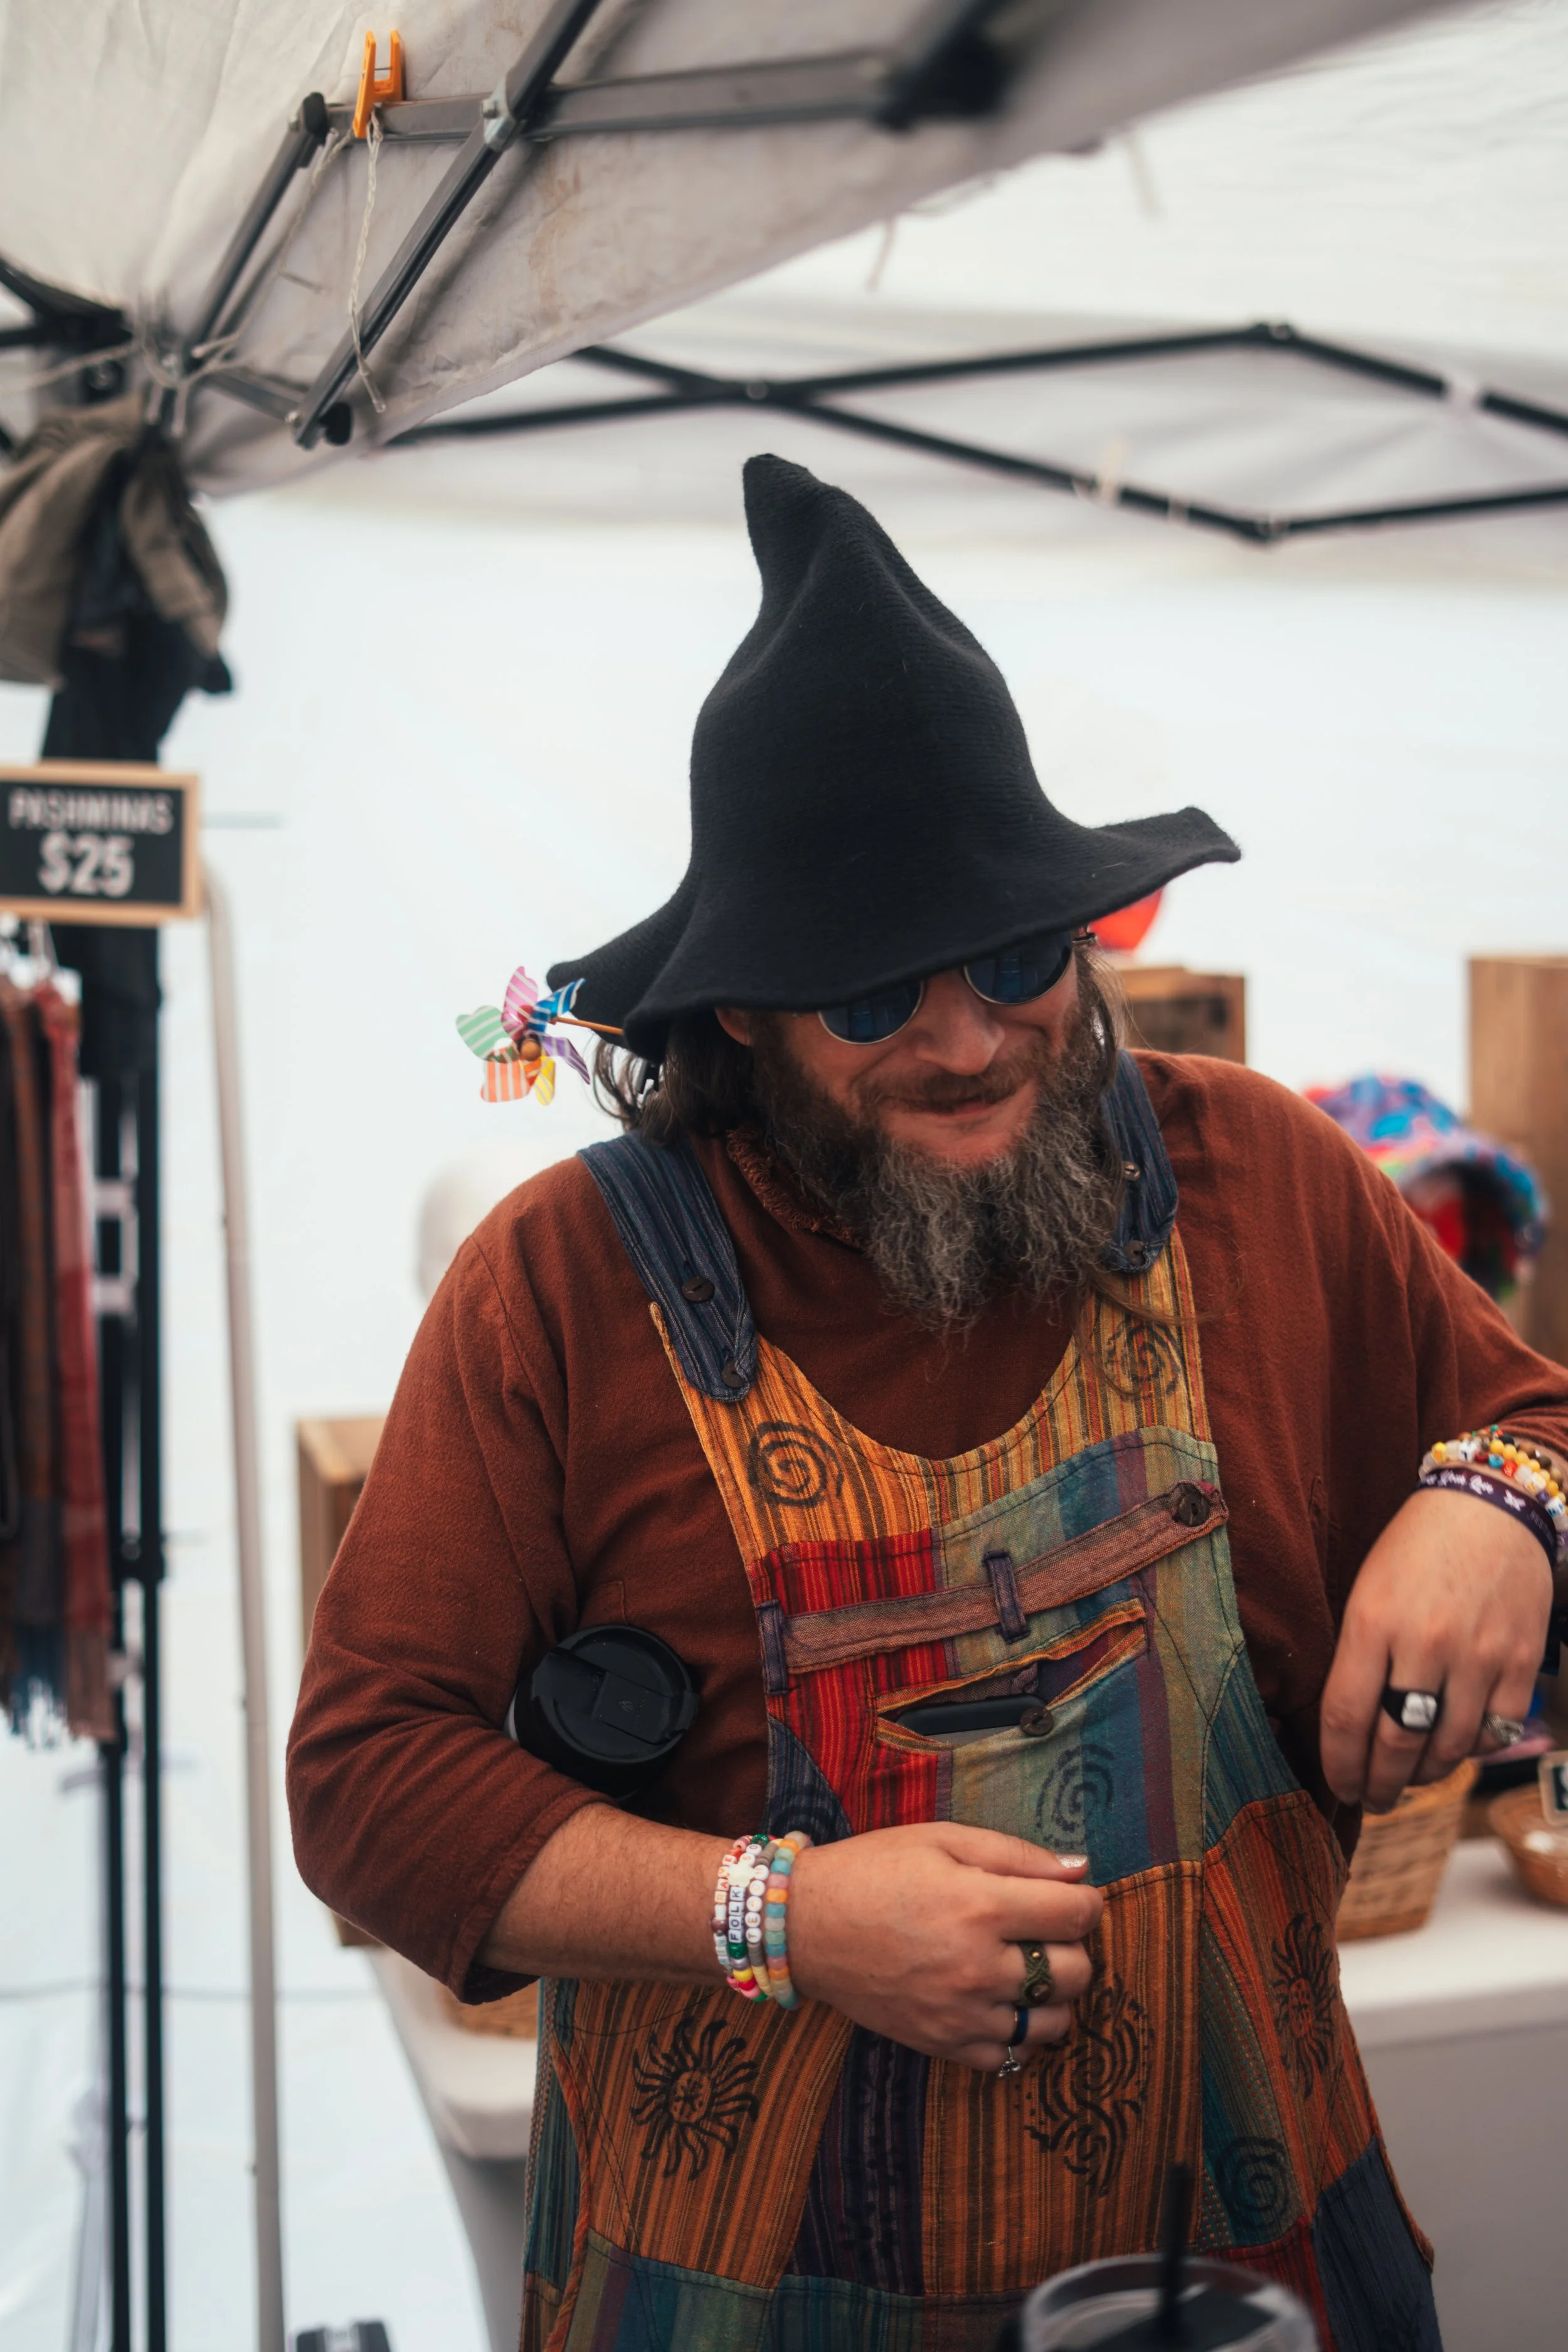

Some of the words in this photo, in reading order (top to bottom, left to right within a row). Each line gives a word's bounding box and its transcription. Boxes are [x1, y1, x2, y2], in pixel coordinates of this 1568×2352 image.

[9, 788, 174, 834] PASHMINAS
[39, 830, 134, 897] $25
[729, 1889, 741, 1942] FOLK
